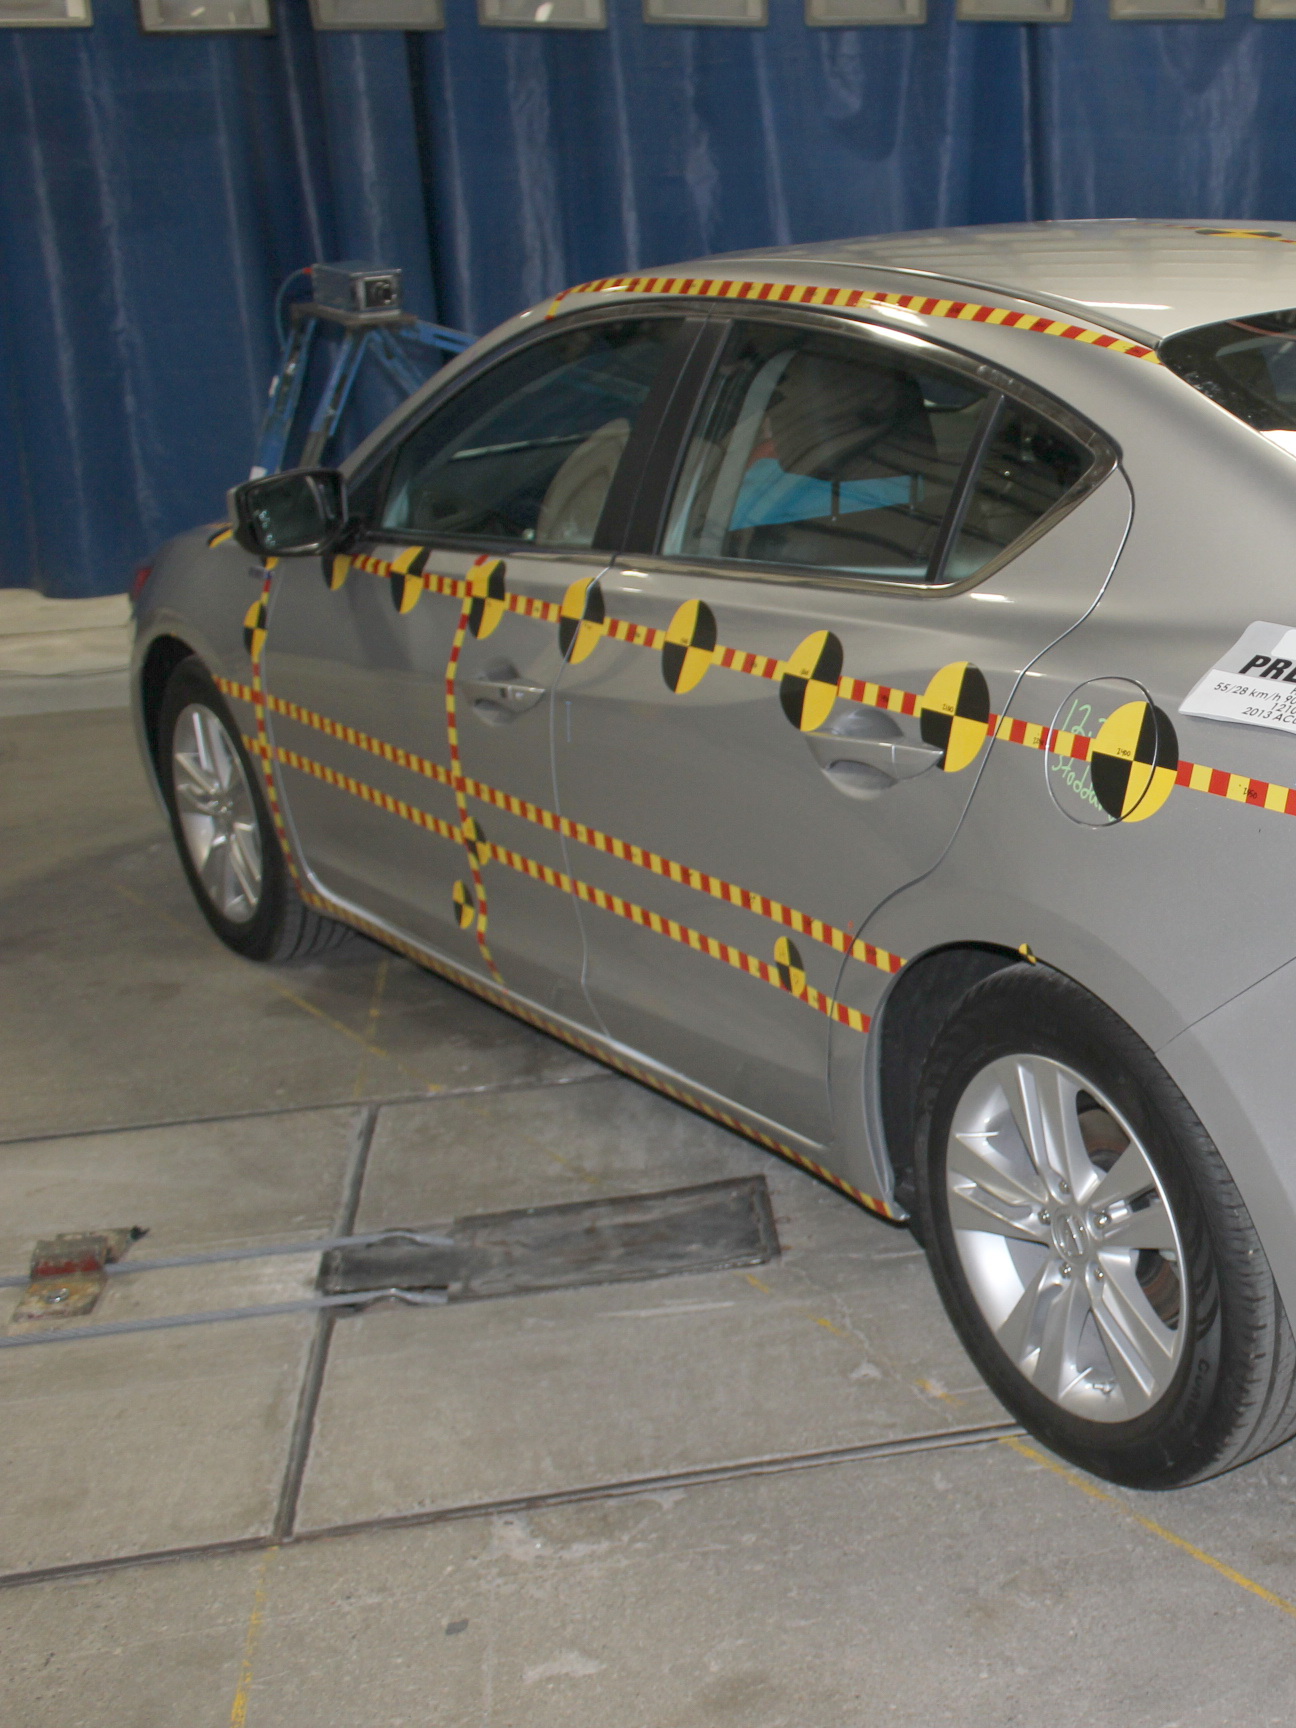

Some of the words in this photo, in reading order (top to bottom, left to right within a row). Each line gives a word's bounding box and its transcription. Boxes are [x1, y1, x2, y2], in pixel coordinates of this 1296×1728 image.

[1213, 682, 1249, 695] 55/28
[1249, 688, 1282, 701] km/h
[1241, 706, 1273, 719] 2013
